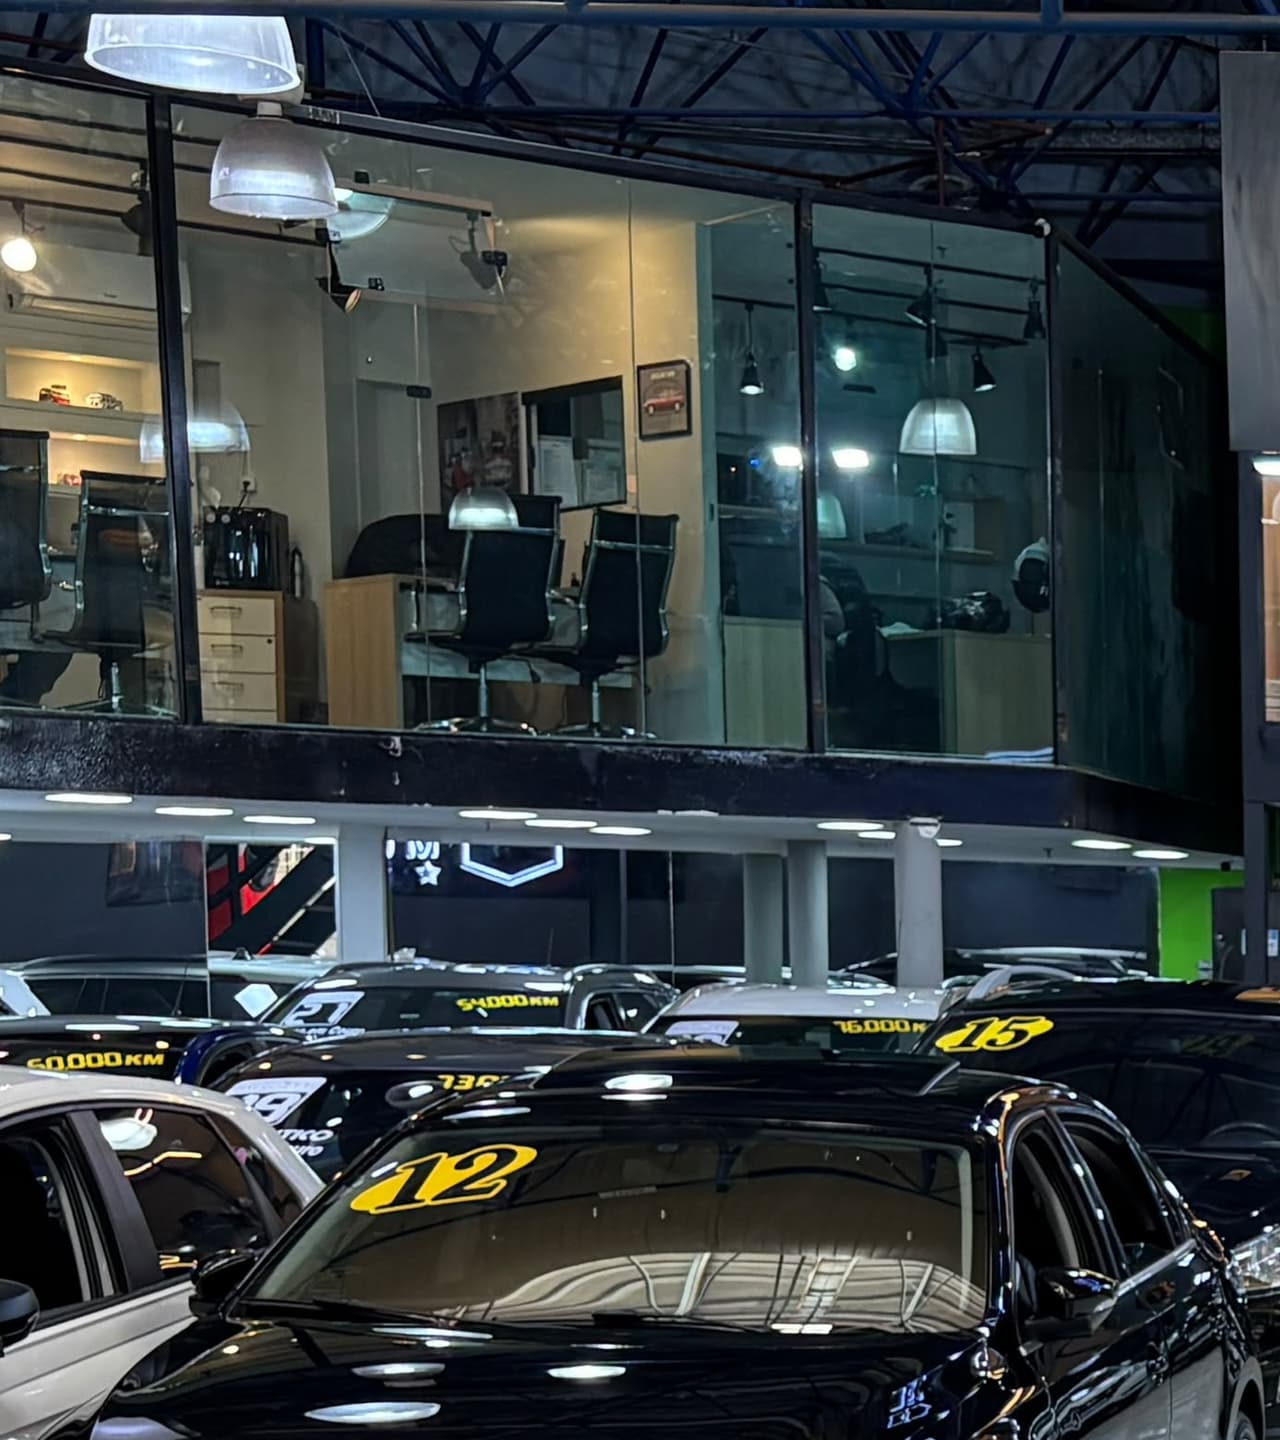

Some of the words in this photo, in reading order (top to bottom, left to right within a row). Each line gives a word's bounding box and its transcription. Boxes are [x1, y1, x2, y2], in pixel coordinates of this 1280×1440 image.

[529, 996, 559, 1007] KM
[943, 1016, 1048, 1051] 15
[124, 1053, 165, 1067] KM
[366, 1145, 522, 1213] 12
